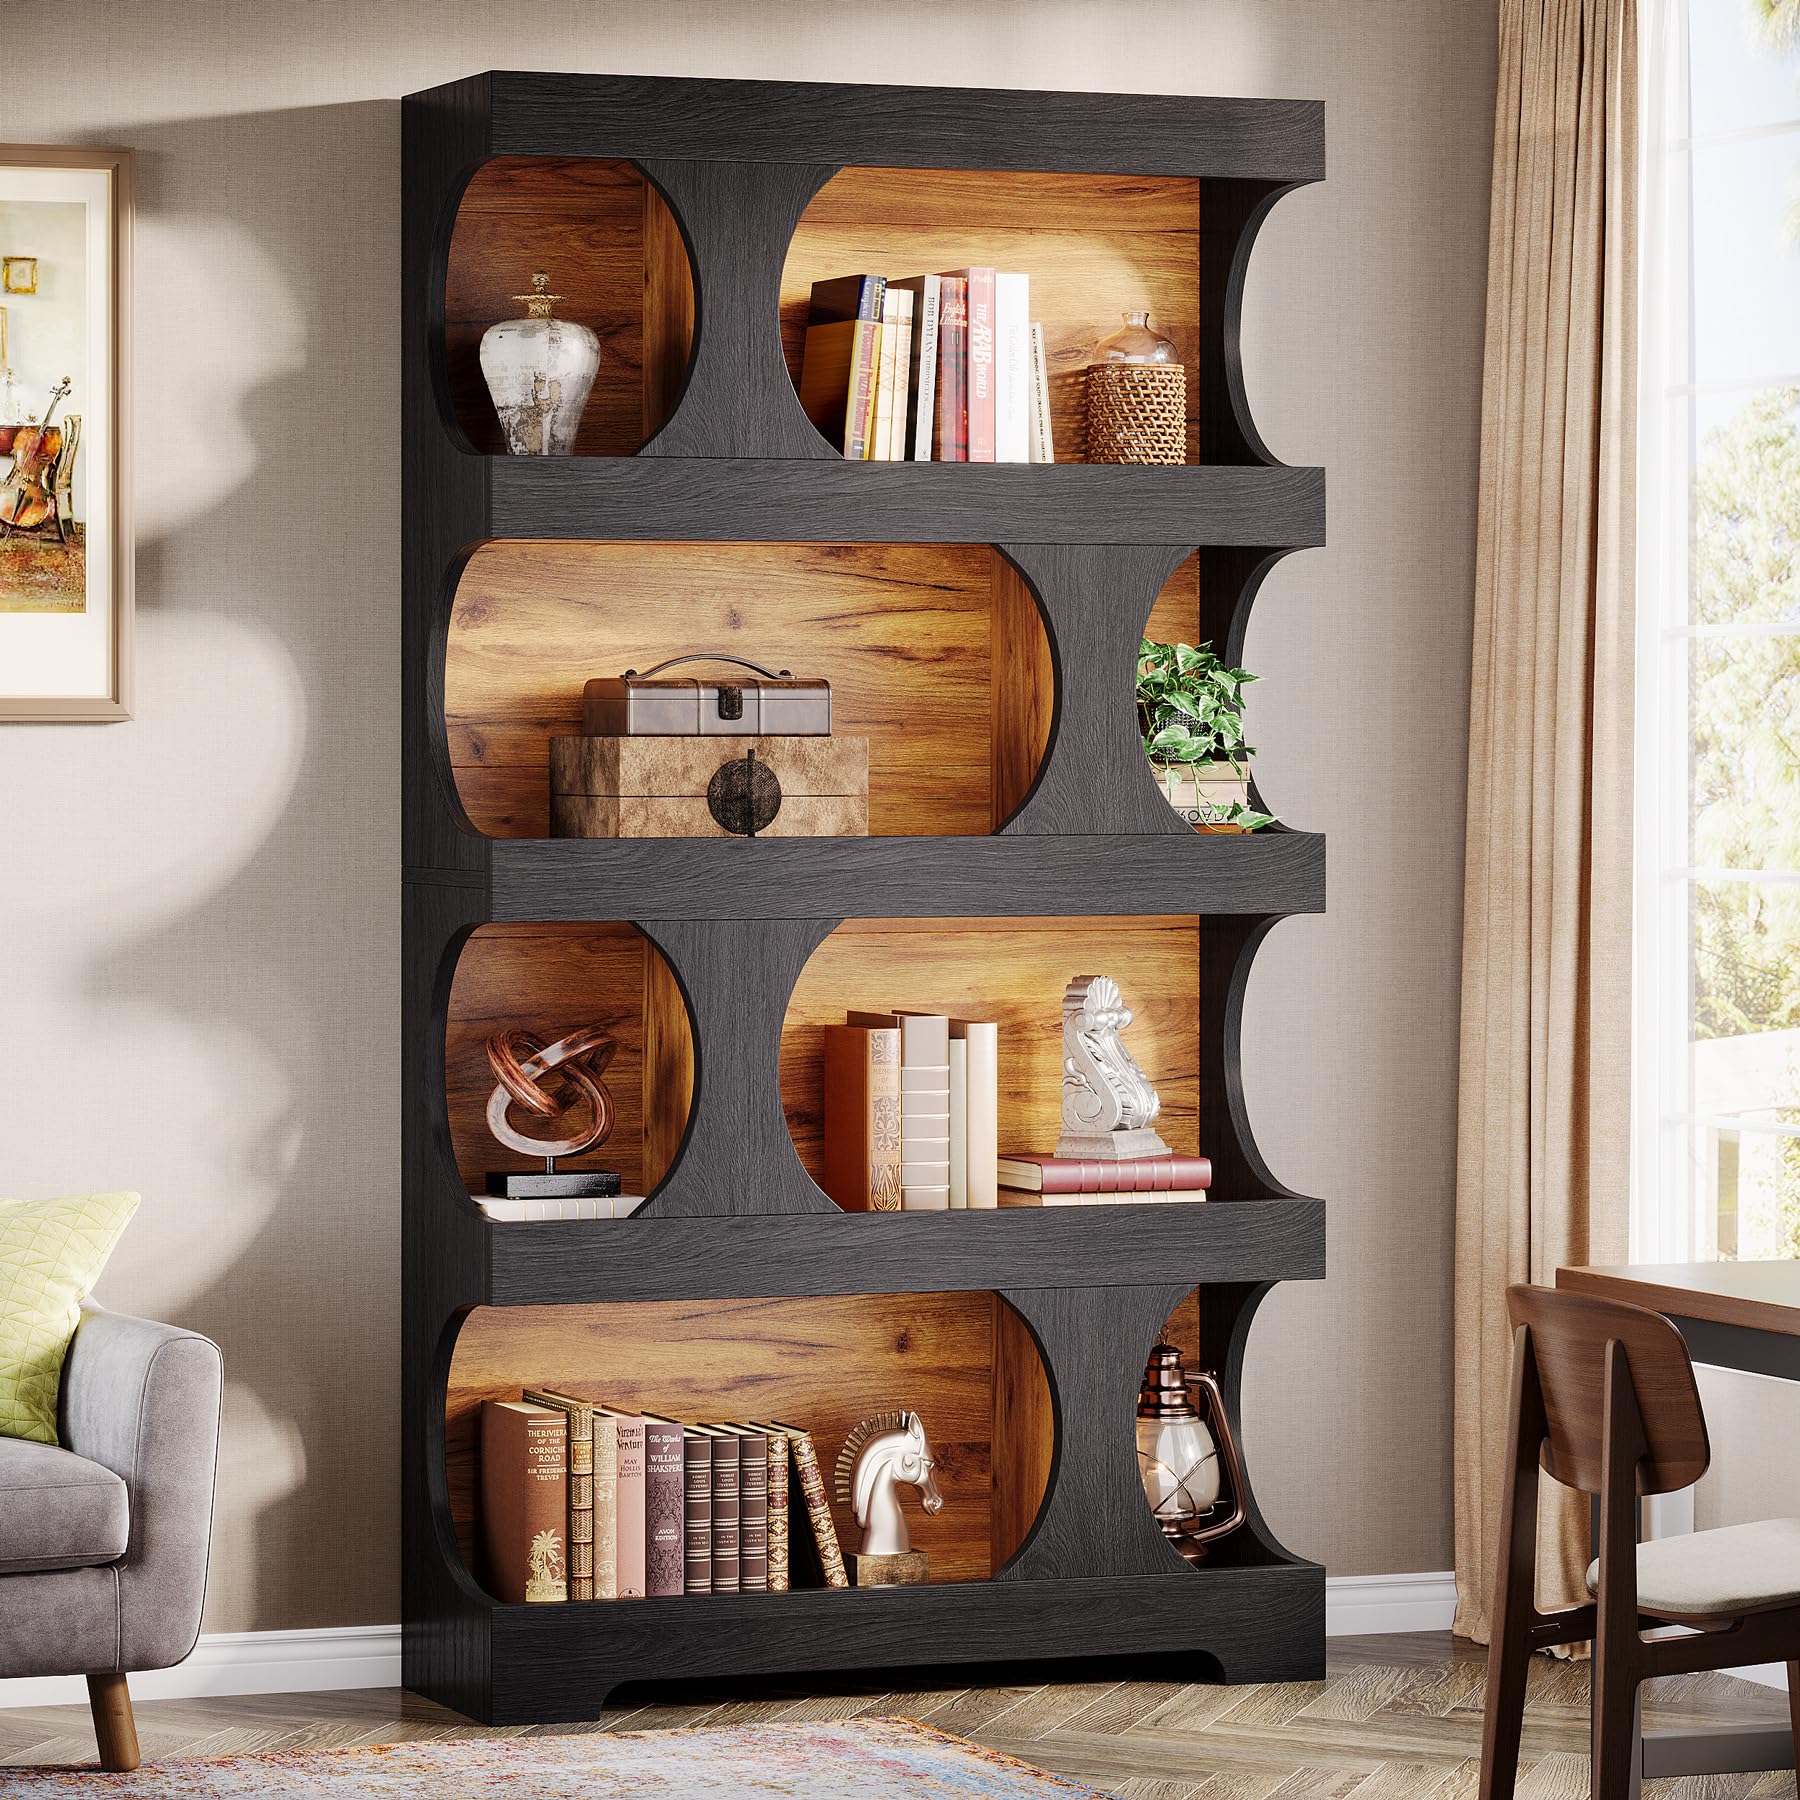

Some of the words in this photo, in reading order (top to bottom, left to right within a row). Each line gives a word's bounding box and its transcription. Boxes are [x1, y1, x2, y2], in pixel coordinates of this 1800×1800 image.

[860, 281, 872, 318] Complete
[927, 296, 936, 316] BOB
[944, 302, 966, 318] English
[976, 304, 987, 322] THE
[925, 319, 934, 353] DYLAN
[972, 320, 992, 364] ARAB
[860, 324, 877, 369] Crossword
[858, 371, 874, 397] Puzzle
[976, 364, 987, 398] WORLD
[542, 1429, 567, 1437] RIVIERA
[662, 1434, 681, 1442] Works
[616, 1439, 643, 1450] Venture
[663, 1444, 670, 1452] of
[650, 1454, 681, 1462] WILLIAM
[647, 1464, 684, 1472] SHAKSPERE
